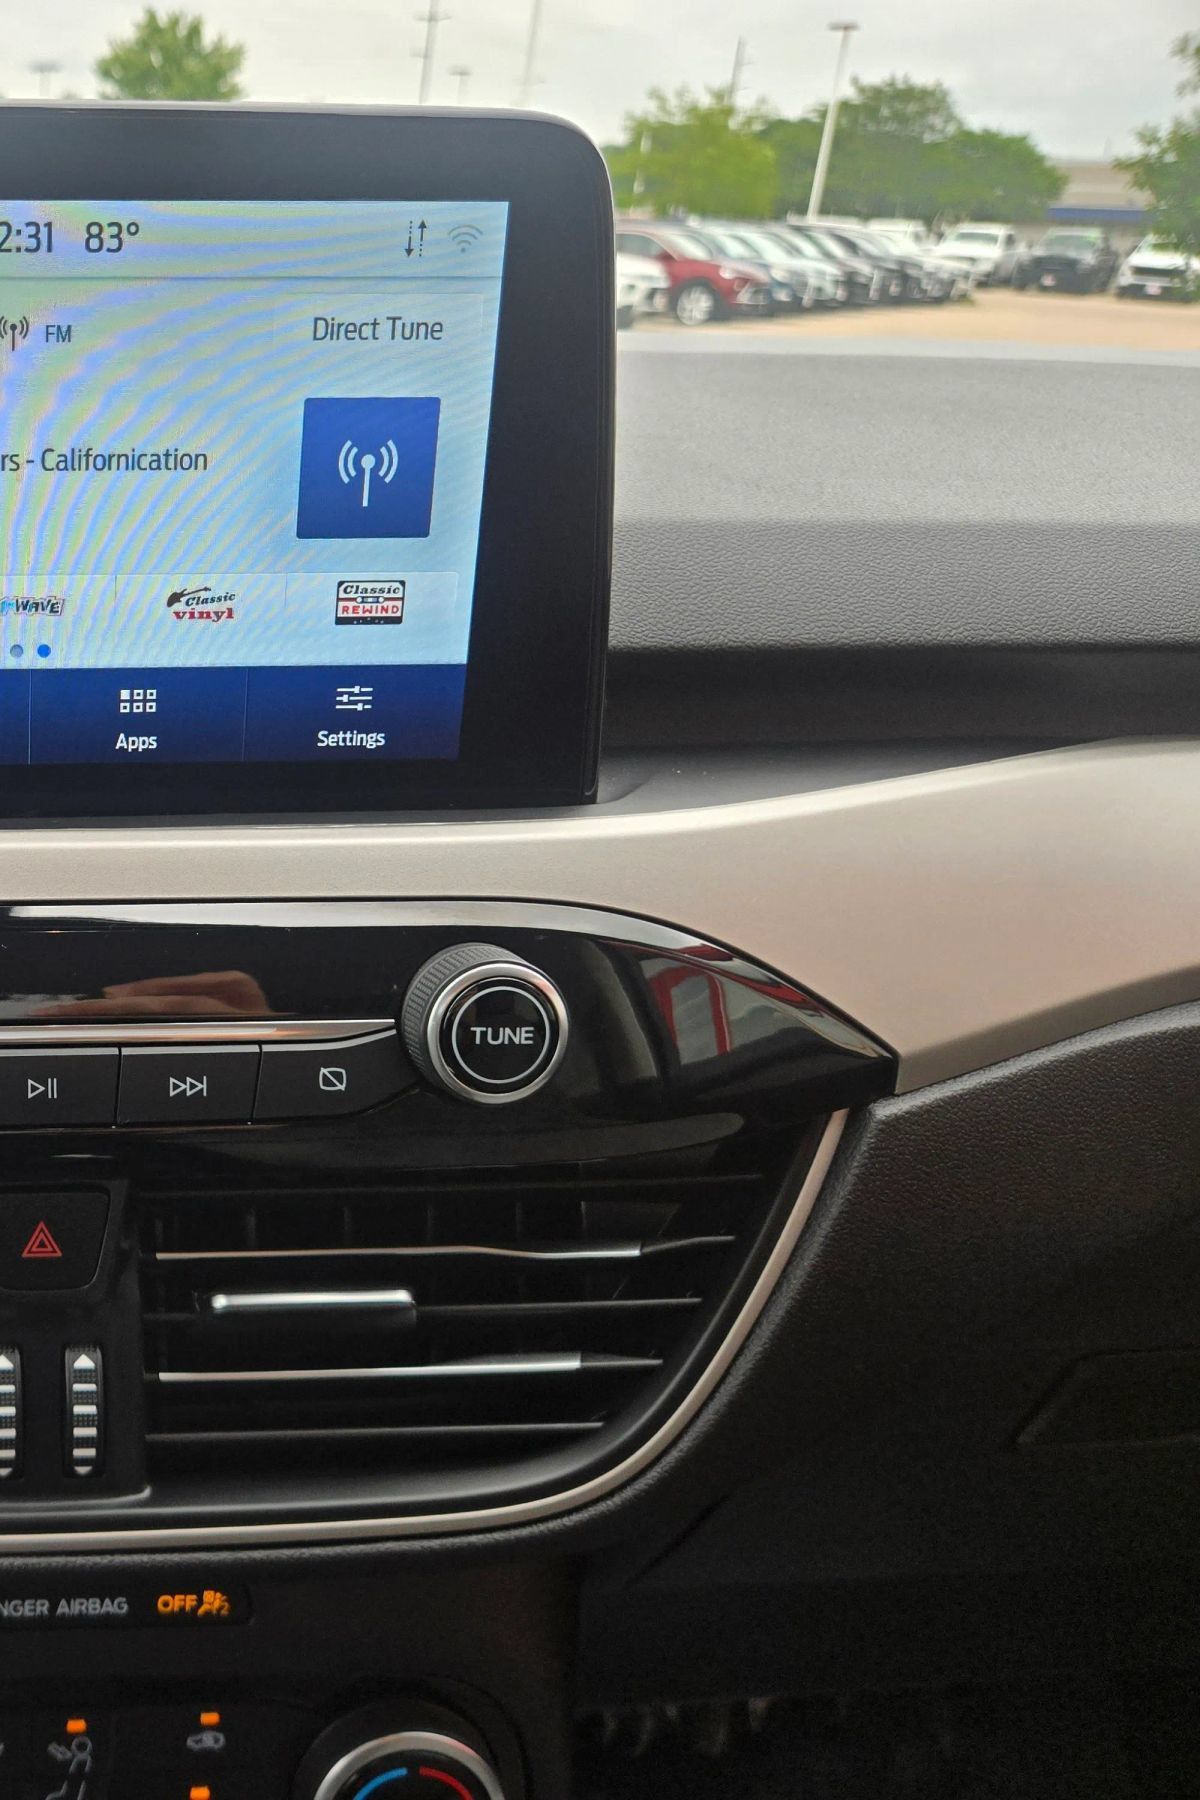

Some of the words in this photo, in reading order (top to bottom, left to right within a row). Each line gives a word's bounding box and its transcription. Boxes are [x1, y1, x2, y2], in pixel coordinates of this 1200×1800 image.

[84, 221, 141, 254] 83°
[45, 324, 72, 343] FM
[312, 316, 380, 341] Direct
[386, 316, 444, 341] Tune
[41, 447, 208, 472] Californication
[185, 591, 236, 607] Classic
[343, 584, 401, 595] Classic
[172, 607, 235, 623] vinyl
[341, 604, 400, 615] REWIND
[115, 732, 158, 752] Apps
[317, 730, 386, 750] Settings
[470, 1026, 534, 1045] TUNE
[56, 1597, 129, 1616] AIRBAG
[157, 1594, 198, 1614] OFF
